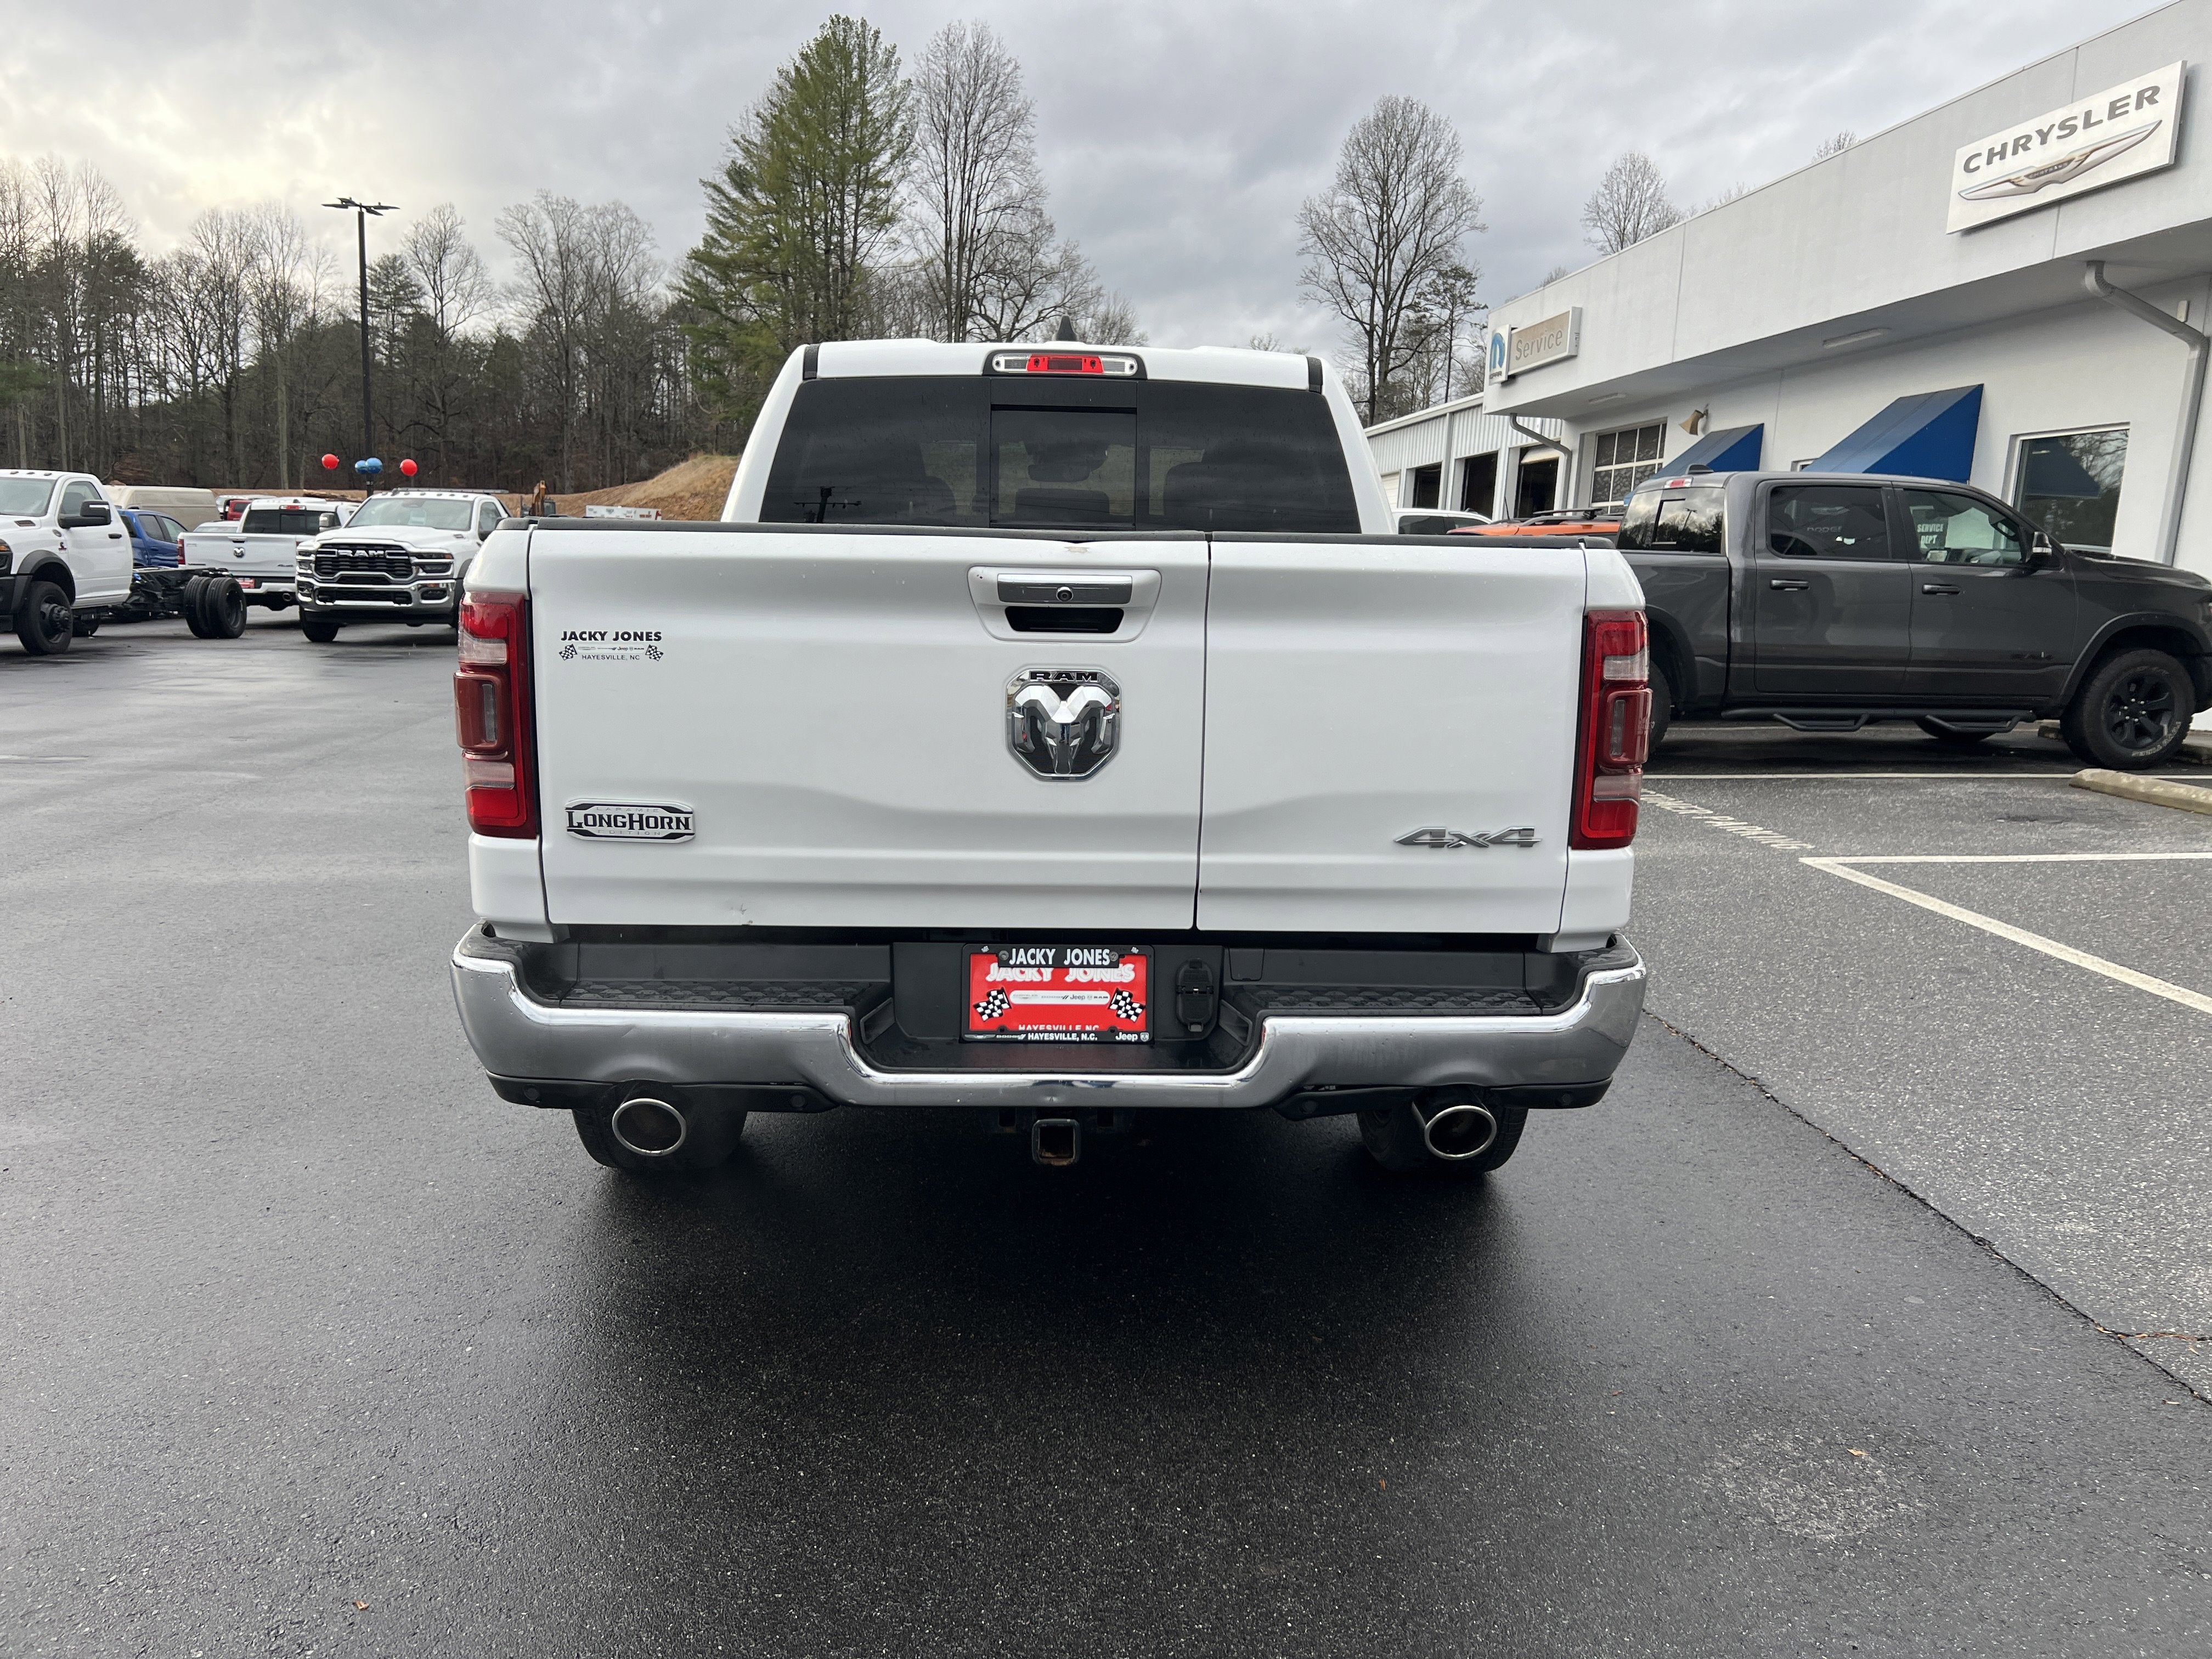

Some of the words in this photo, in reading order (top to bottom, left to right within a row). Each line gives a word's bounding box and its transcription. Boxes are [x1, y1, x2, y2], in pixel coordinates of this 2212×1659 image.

[1963, 86, 2160, 173] CHRYSLER
[1515, 329, 1562, 360] Service
[1917, 524, 1944, 532] SERVICE
[1921, 534, 1938, 544] DEPT
[561, 631, 608, 641] JACKY
[612, 631, 662, 641] JONES
[1030, 672, 1097, 682] RAM
[566, 811, 692, 830] LONGHORN
[1009, 948, 1056, 965] JACKY
[1064, 948, 1110, 966] JONES
[985, 963, 1054, 982] JACKY
[1065, 964, 1135, 983] JONES
[1028, 1032, 1079, 1041] HAYESVILLE,
[1115, 1032, 1138, 1041] Jeep
